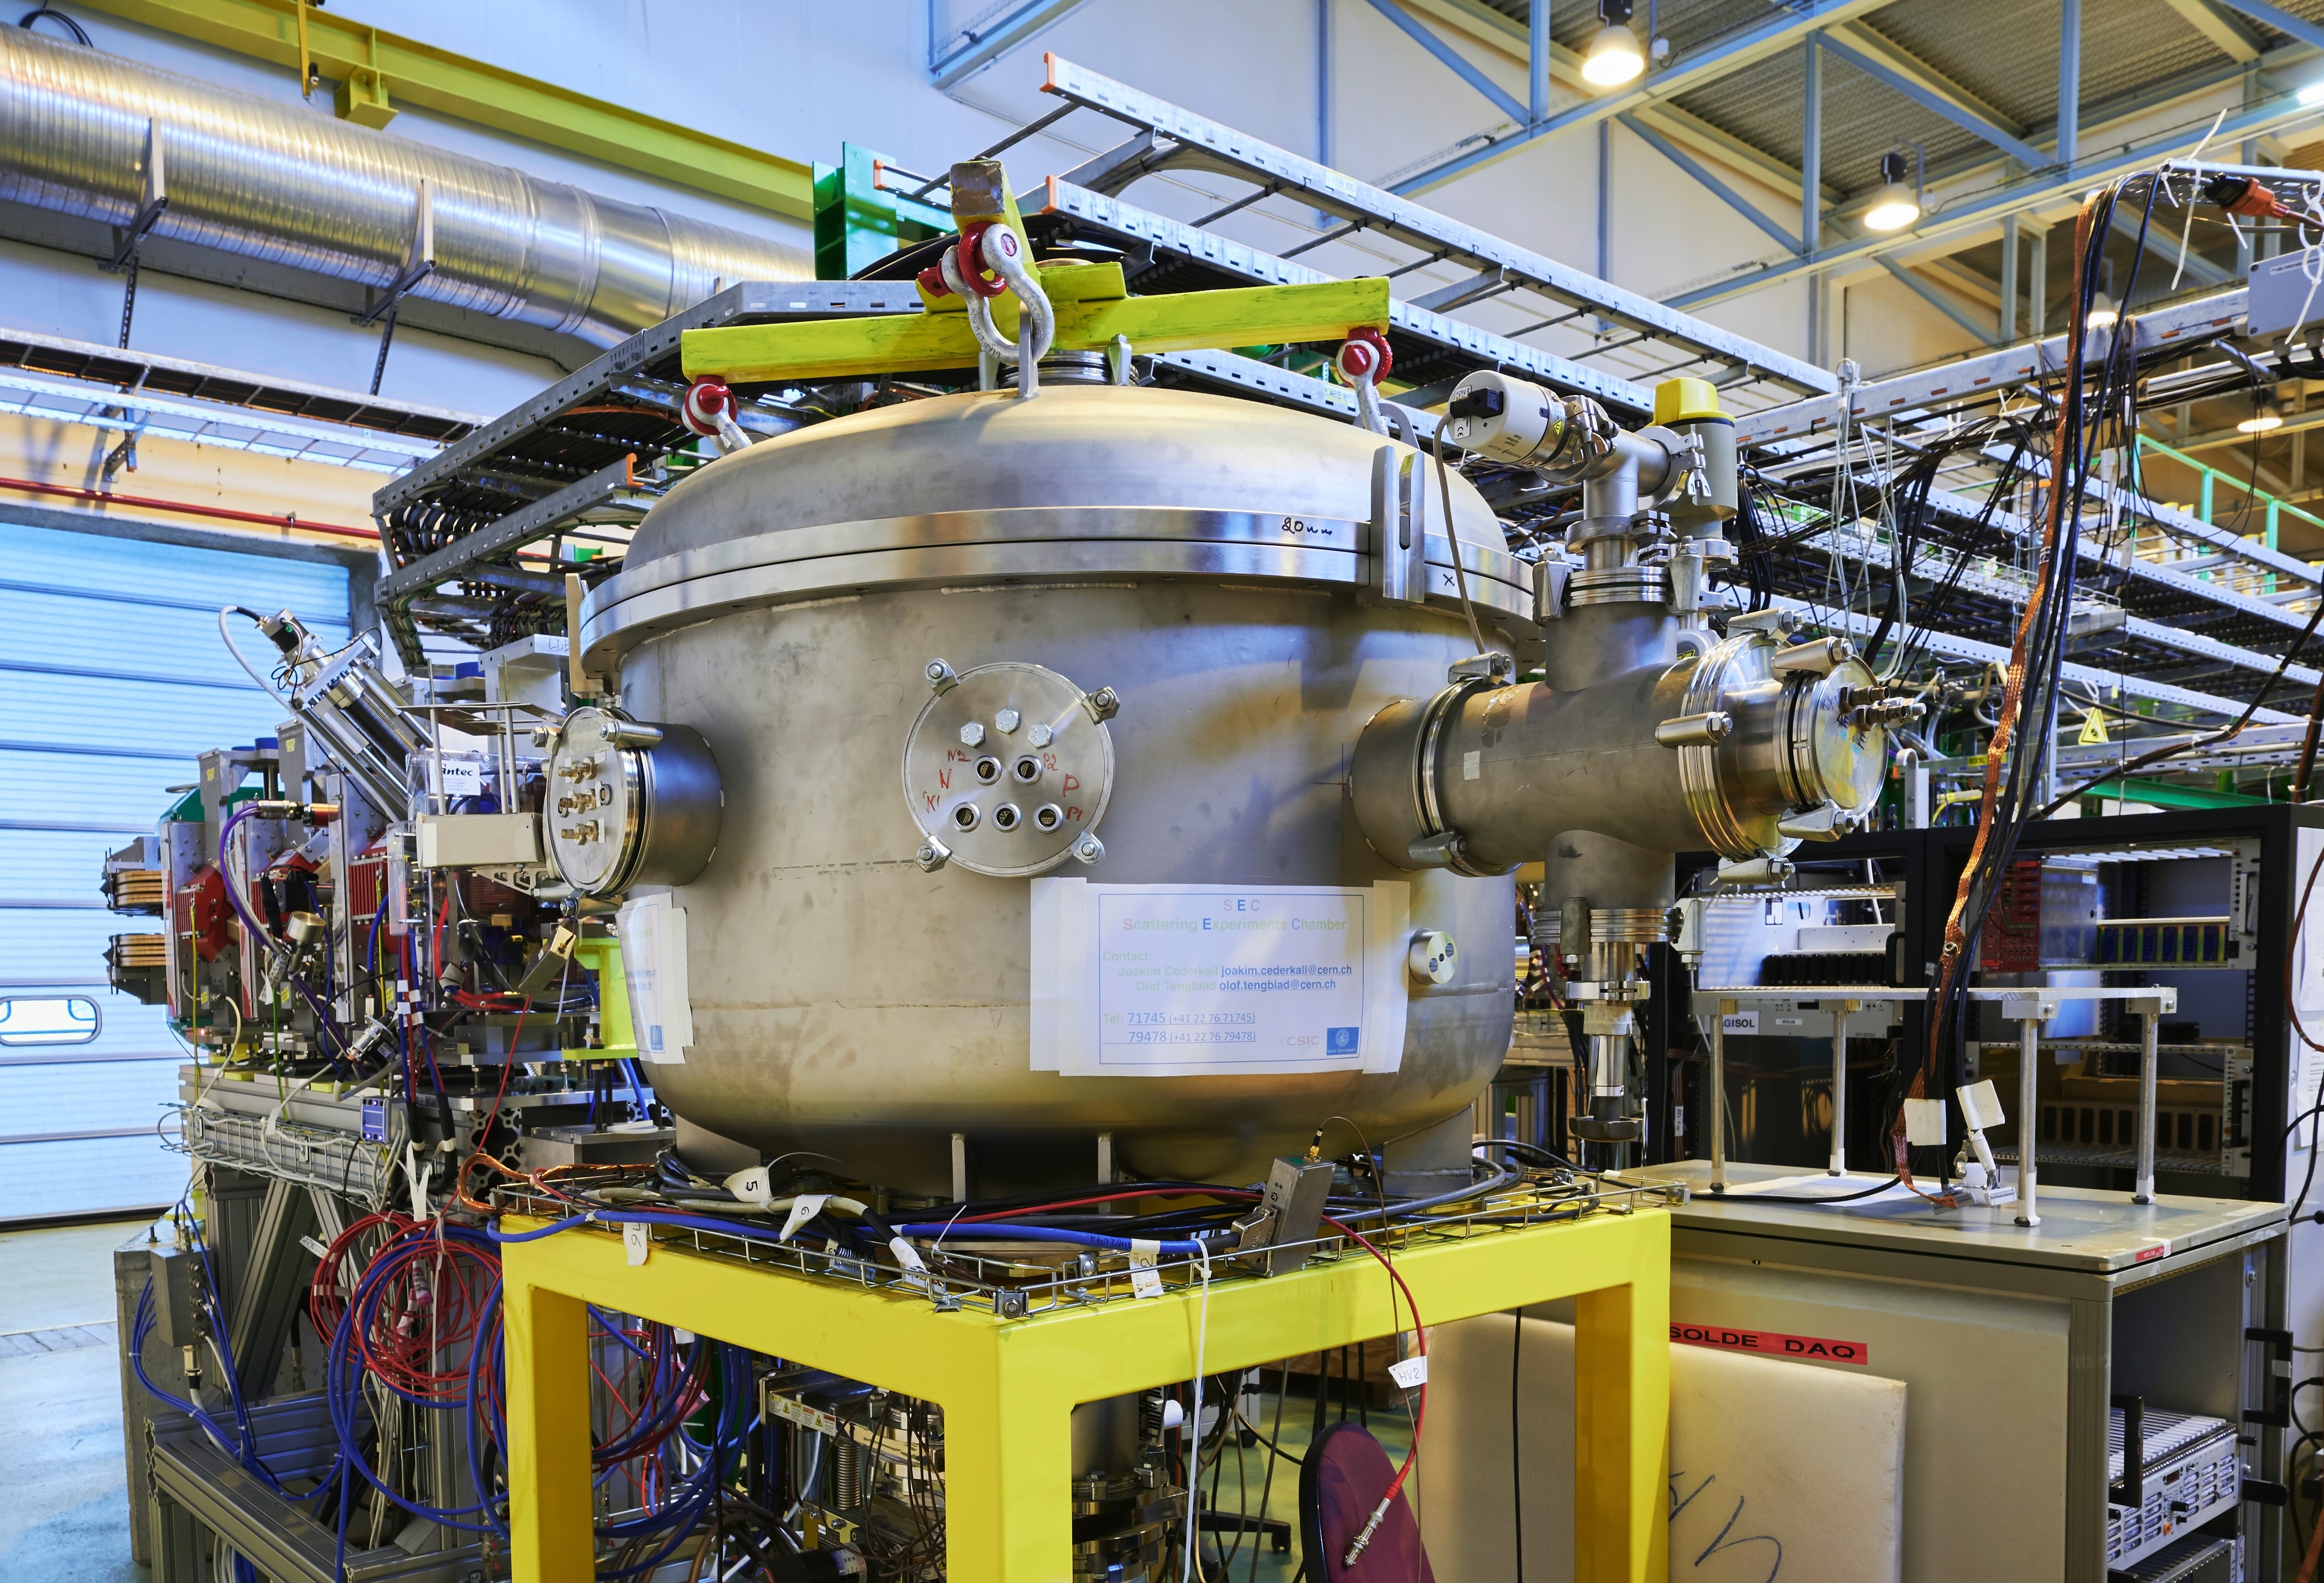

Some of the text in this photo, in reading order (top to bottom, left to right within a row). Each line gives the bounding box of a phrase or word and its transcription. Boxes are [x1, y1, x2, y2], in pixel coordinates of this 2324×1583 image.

[939, 768, 952, 789] N
[1063, 773, 1080, 797] P
[1124, 918, 1346, 933] Scattering Experiments Chamber
[1103, 951, 1152, 961] Contact:
[1119, 965, 1352, 978] Joakim Cederkall joakim.cederkall@cern.ch
[1136, 980, 1336, 993] Olof Tengblad olof.tengblad@cern.ch
[1103, 1012, 1255, 1024] Tel: 71745 (+41 22 76 71745)
[1723, 1019, 1755, 1028] GISOL
[1129, 1030, 1256, 1043] 79478 (+41 22 76 79478)
[1286, 1036, 1319, 1046] CSIC
[1785, 1339, 1855, 1358] DAQ
[1398, 1367, 1420, 1382] HV2
